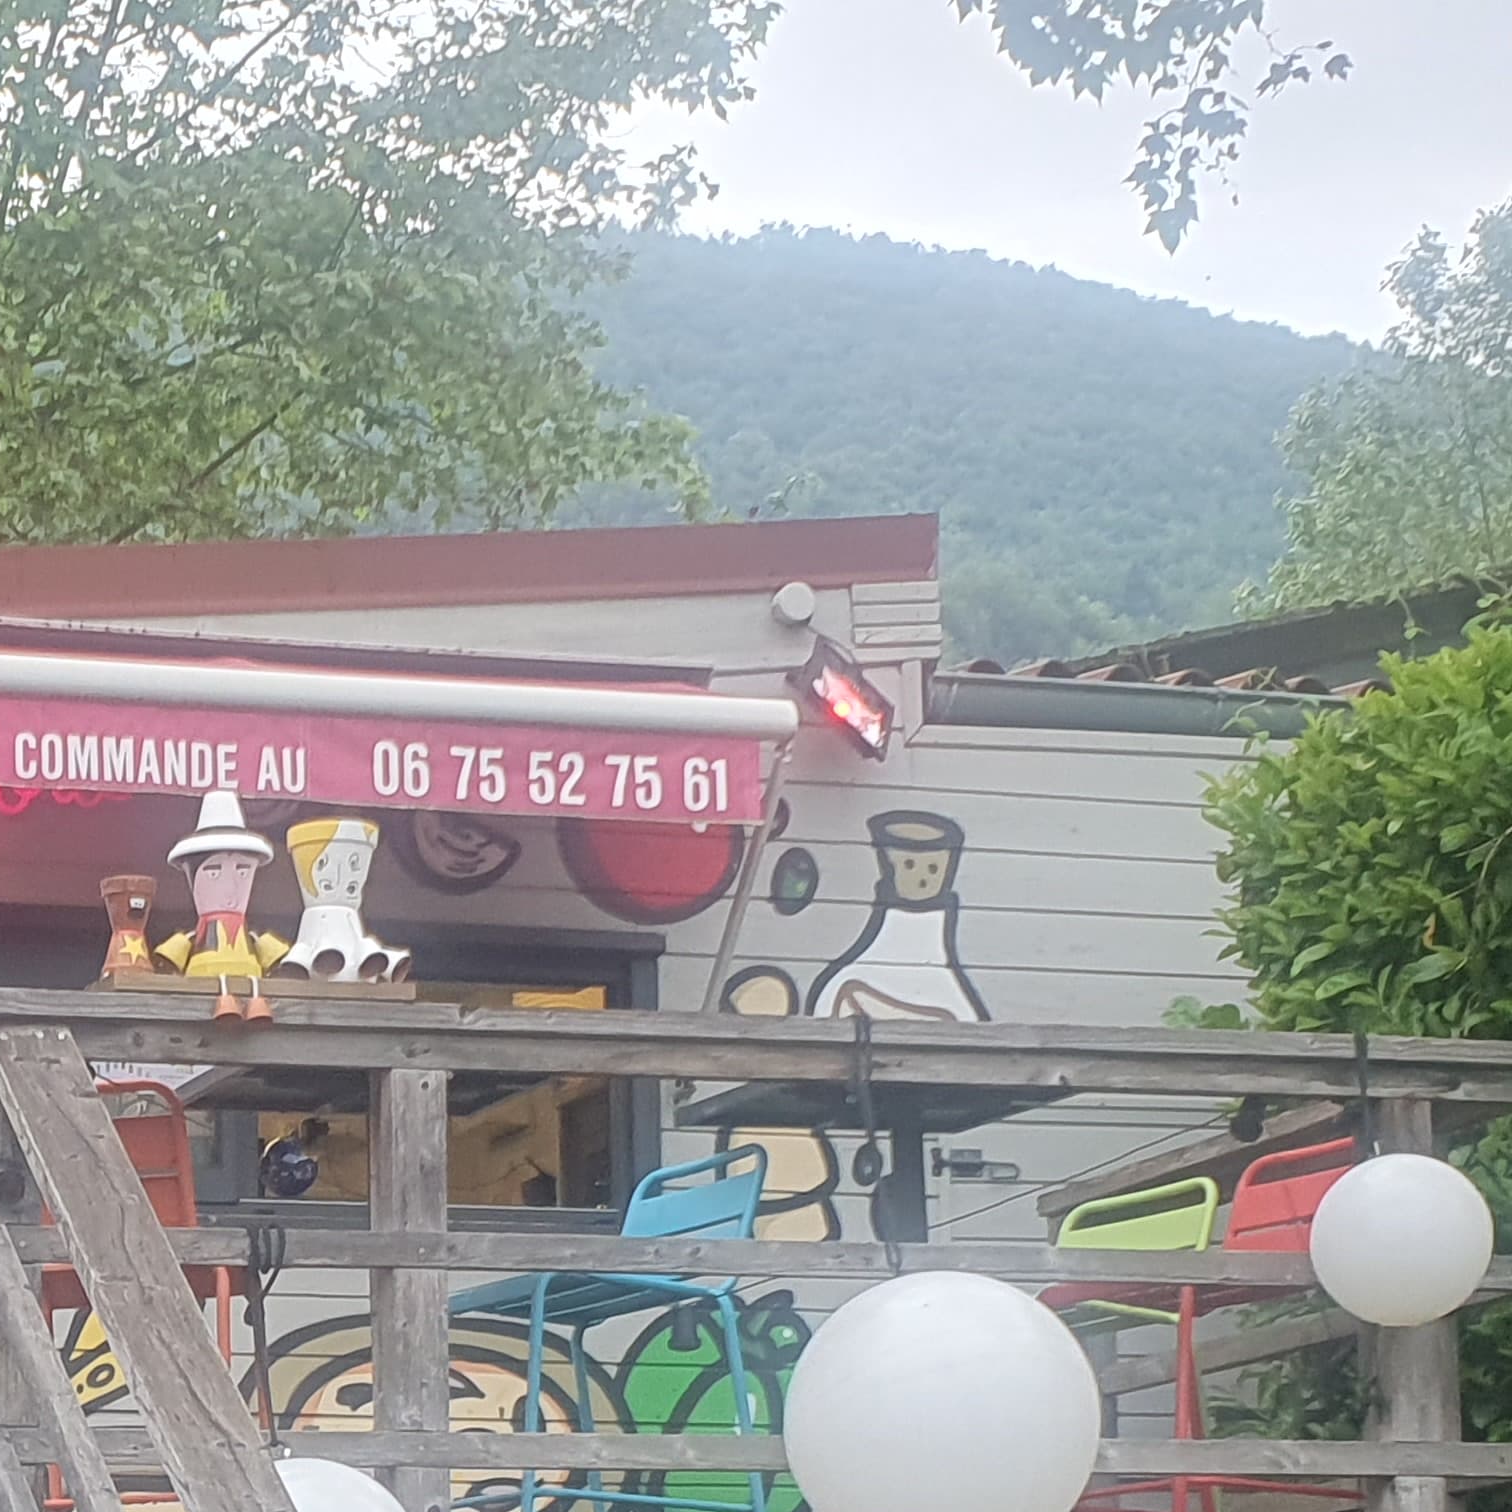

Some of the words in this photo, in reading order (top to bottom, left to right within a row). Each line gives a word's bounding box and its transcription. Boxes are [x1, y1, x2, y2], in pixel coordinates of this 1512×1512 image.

[14, 731, 240, 790] COMMANDE
[257, 745, 307, 794] AU
[372, 740, 431, 798] 06
[450, 745, 507, 803] 75
[527, 751, 586, 807] 52
[604, 754, 663, 810] 75
[682, 756, 729, 813] 61
